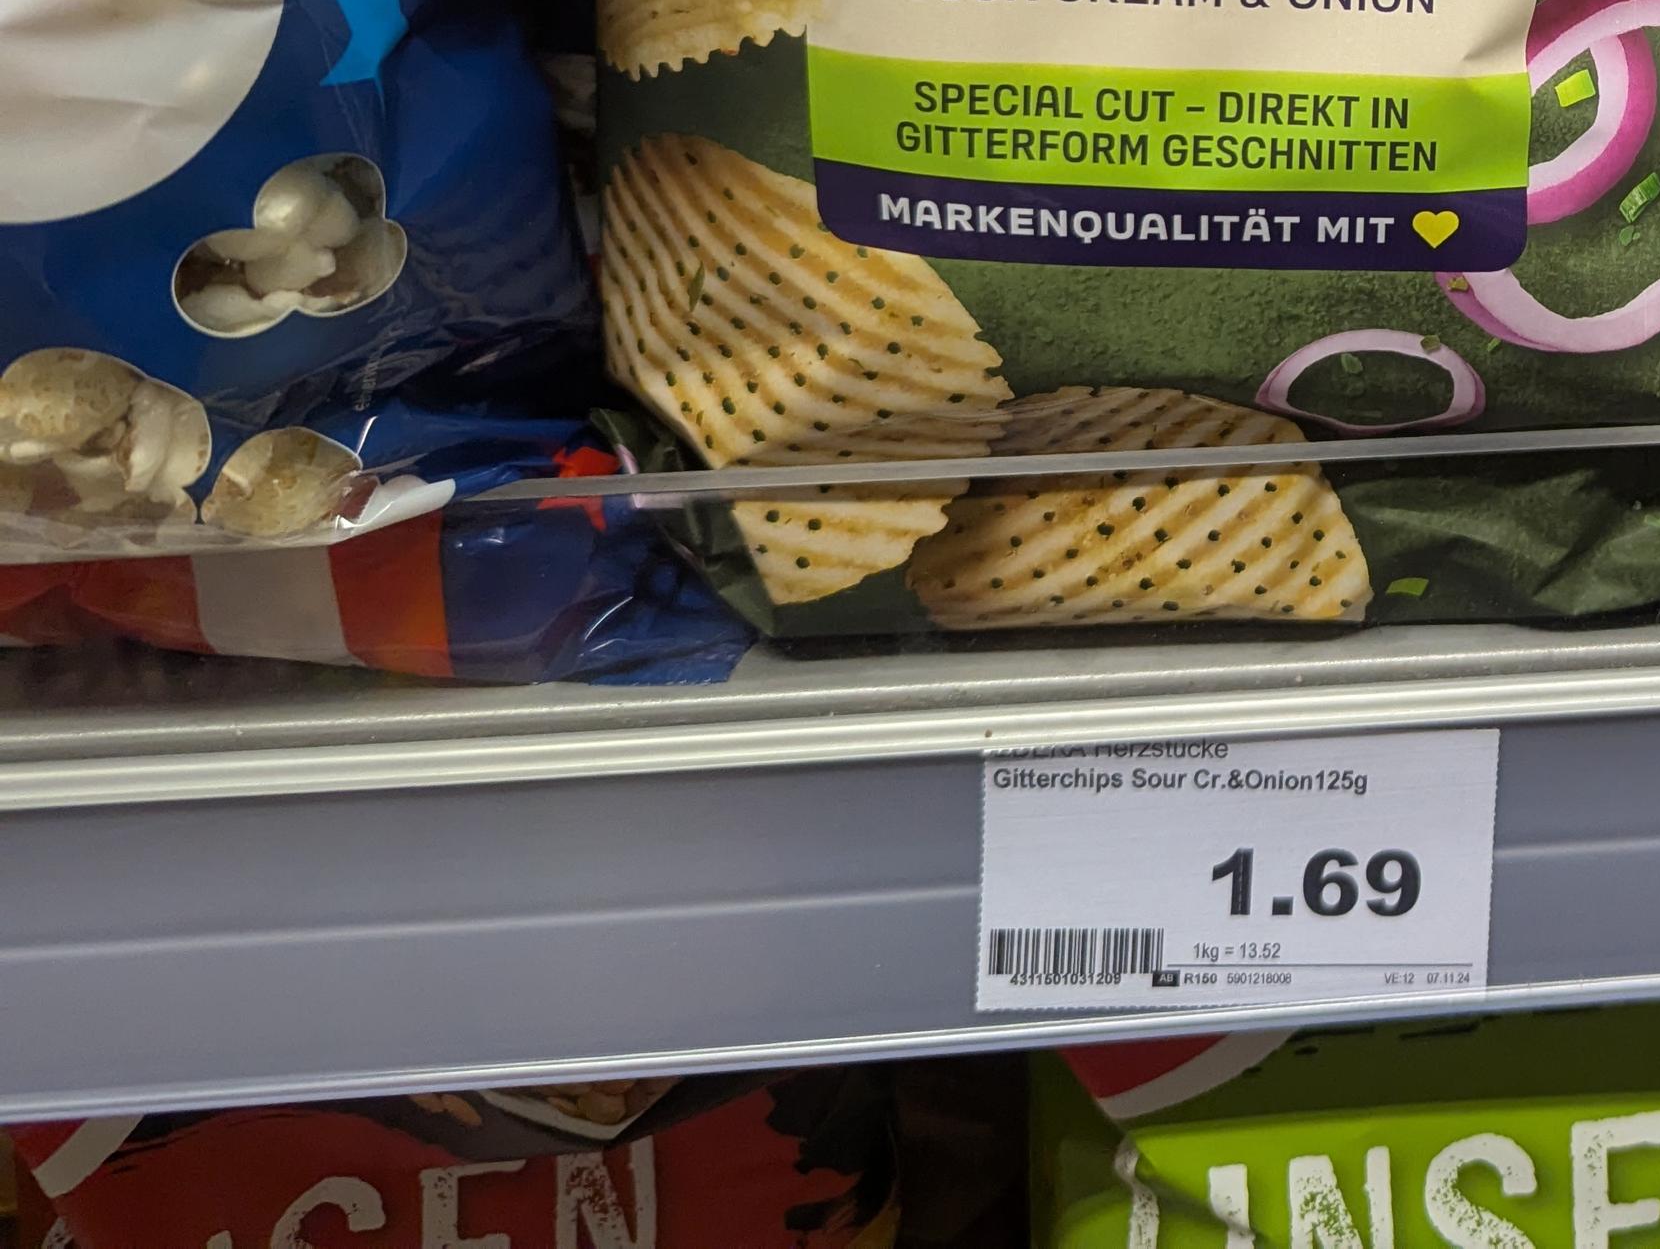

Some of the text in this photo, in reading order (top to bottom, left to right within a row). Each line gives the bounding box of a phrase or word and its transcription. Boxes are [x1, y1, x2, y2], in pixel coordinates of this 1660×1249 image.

[913, 80, 1084, 121] SPECIAL
[1095, 88, 1175, 123] CUT
[1218, 91, 1361, 129] DIREKT
[1370, 96, 1409, 130] IN
[896, 121, 1437, 172] GITTERFORM GESCHNITTEN
[879, 192, 1395, 245] MARKENQUALITÄT MIT
[993, 767, 1369, 795] Gitterchips Sour Cr.&Onion125g
[1211, 847, 1422, 917] 1.69
[1193, 943, 1219, 962] 1kg
[1239, 943, 1281, 960] 13.52
[1184, 973, 1217, 984] R150
[1426, 972, 1471, 985] 07.11.24
